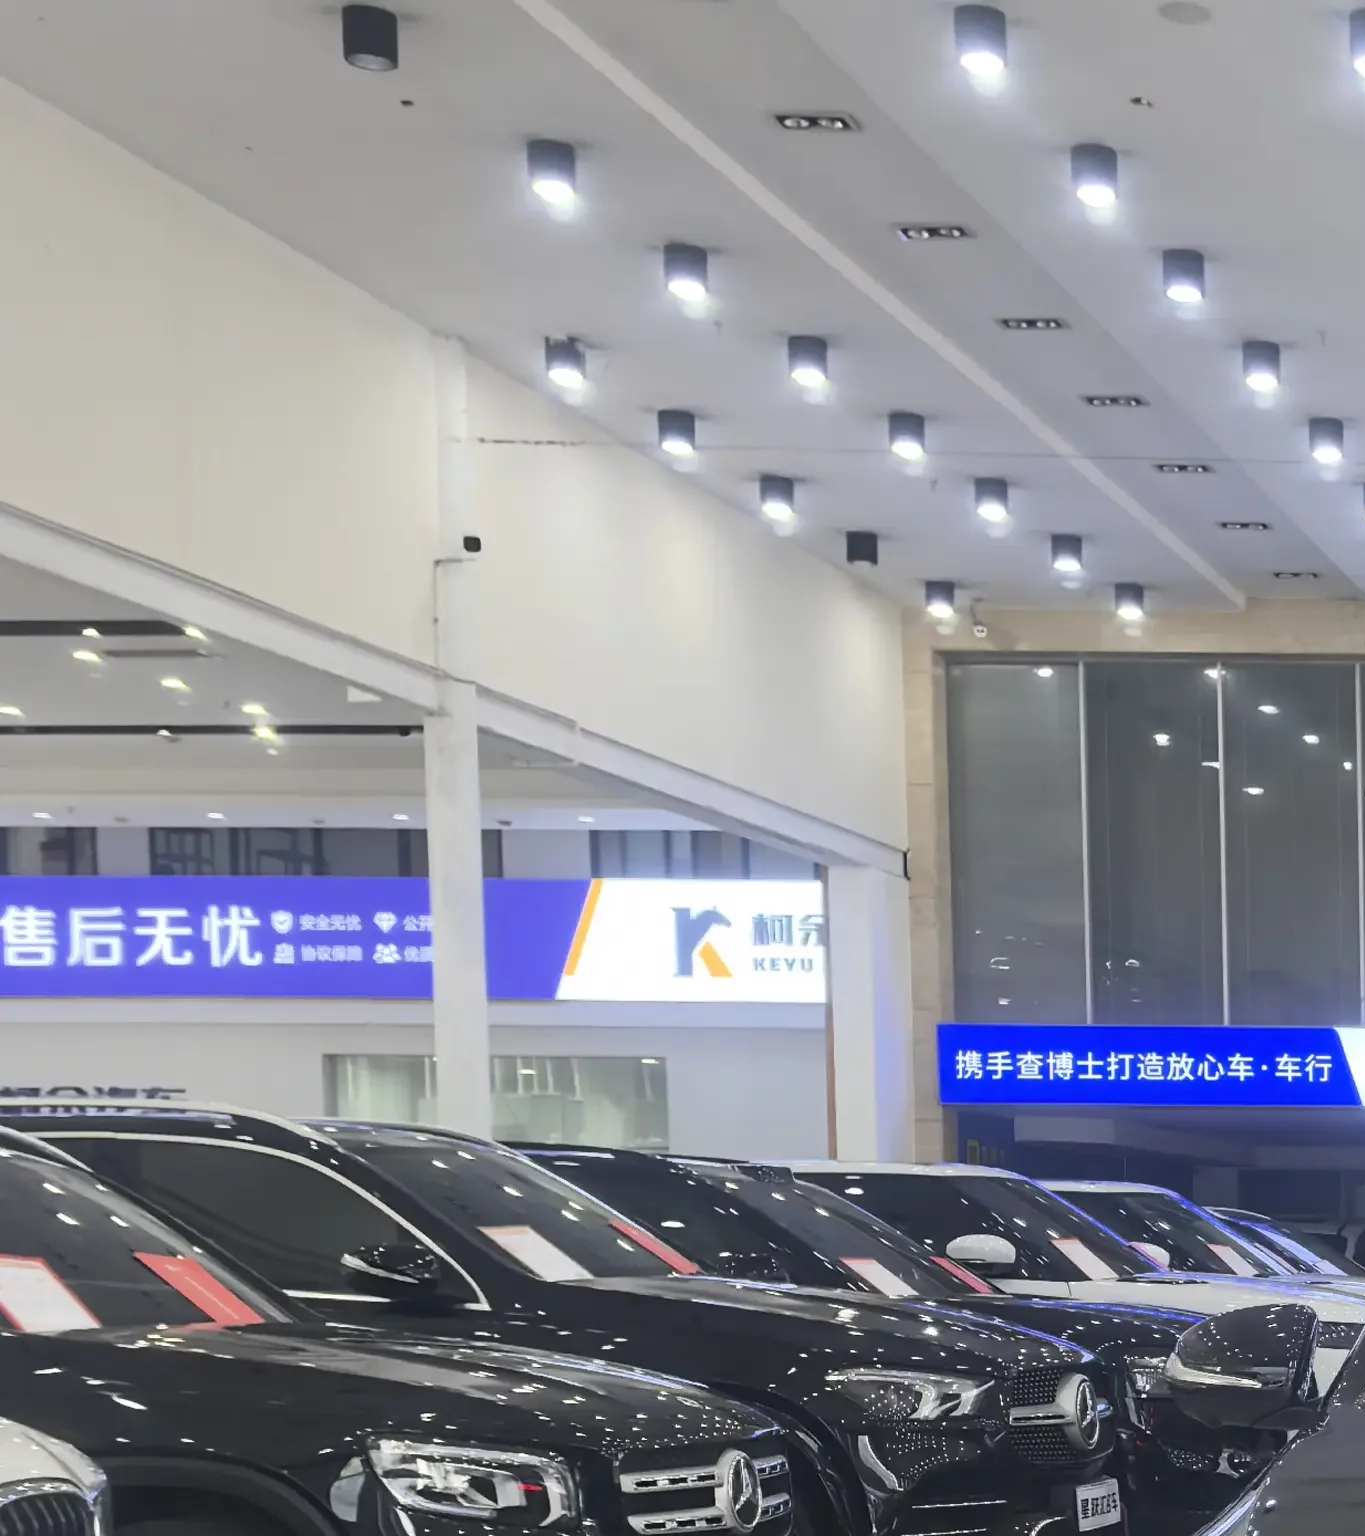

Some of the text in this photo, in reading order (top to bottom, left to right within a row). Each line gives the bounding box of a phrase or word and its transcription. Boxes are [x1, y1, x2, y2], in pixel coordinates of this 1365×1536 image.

[0, 905, 264, 968] 售后无忧
[752, 956, 815, 972] KEYU
[955, 1049, 1333, 1083] 携手查博士打造放心车·车行
